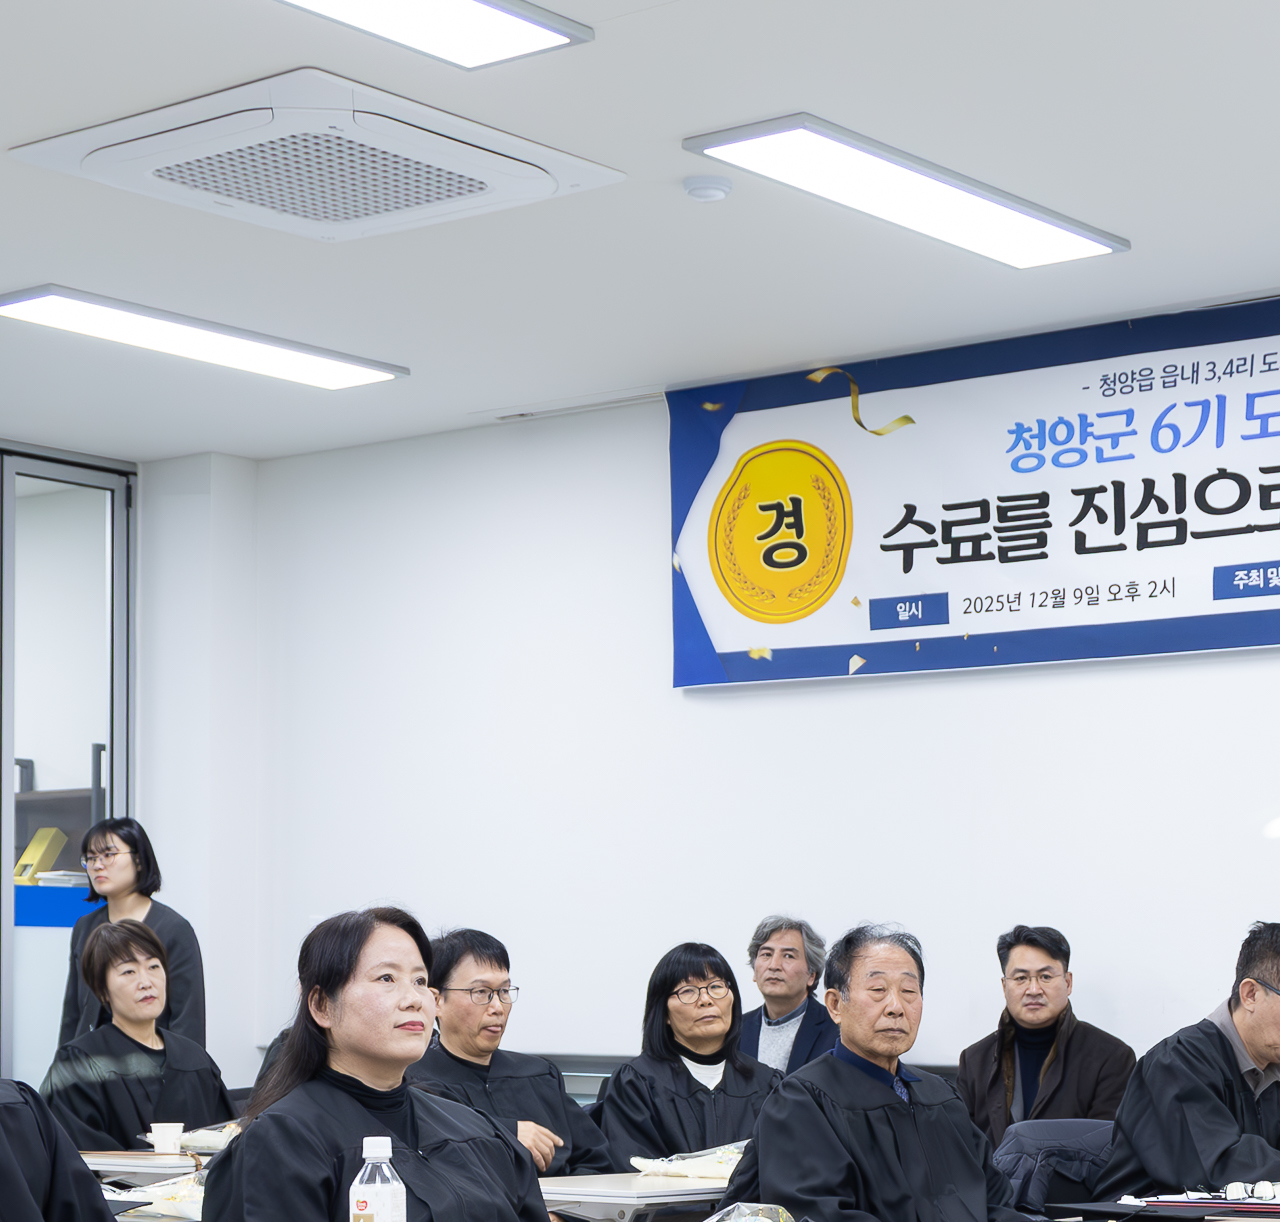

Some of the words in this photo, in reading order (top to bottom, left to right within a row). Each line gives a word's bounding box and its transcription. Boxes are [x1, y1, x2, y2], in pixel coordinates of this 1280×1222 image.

[1099, 366, 1155, 397] 청양읍
[1160, 361, 1200, 388] 읍내
[1205, 353, 1254, 383] 3,4리
[1006, 404, 1138, 474] 청양군
[1149, 393, 1227, 455] 6기
[756, 494, 808, 572] 경
[879, 490, 1053, 574] 수료를
[963, 591, 1022, 615] 2025년
[1029, 587, 1066, 609] 12월
[1073, 584, 1100, 606] 9일
[1106, 580, 1141, 603] 오후
[1147, 576, 1176, 599] 2시
[1233, 568, 1265, 590] 주최
[896, 600, 923, 621] 일시
